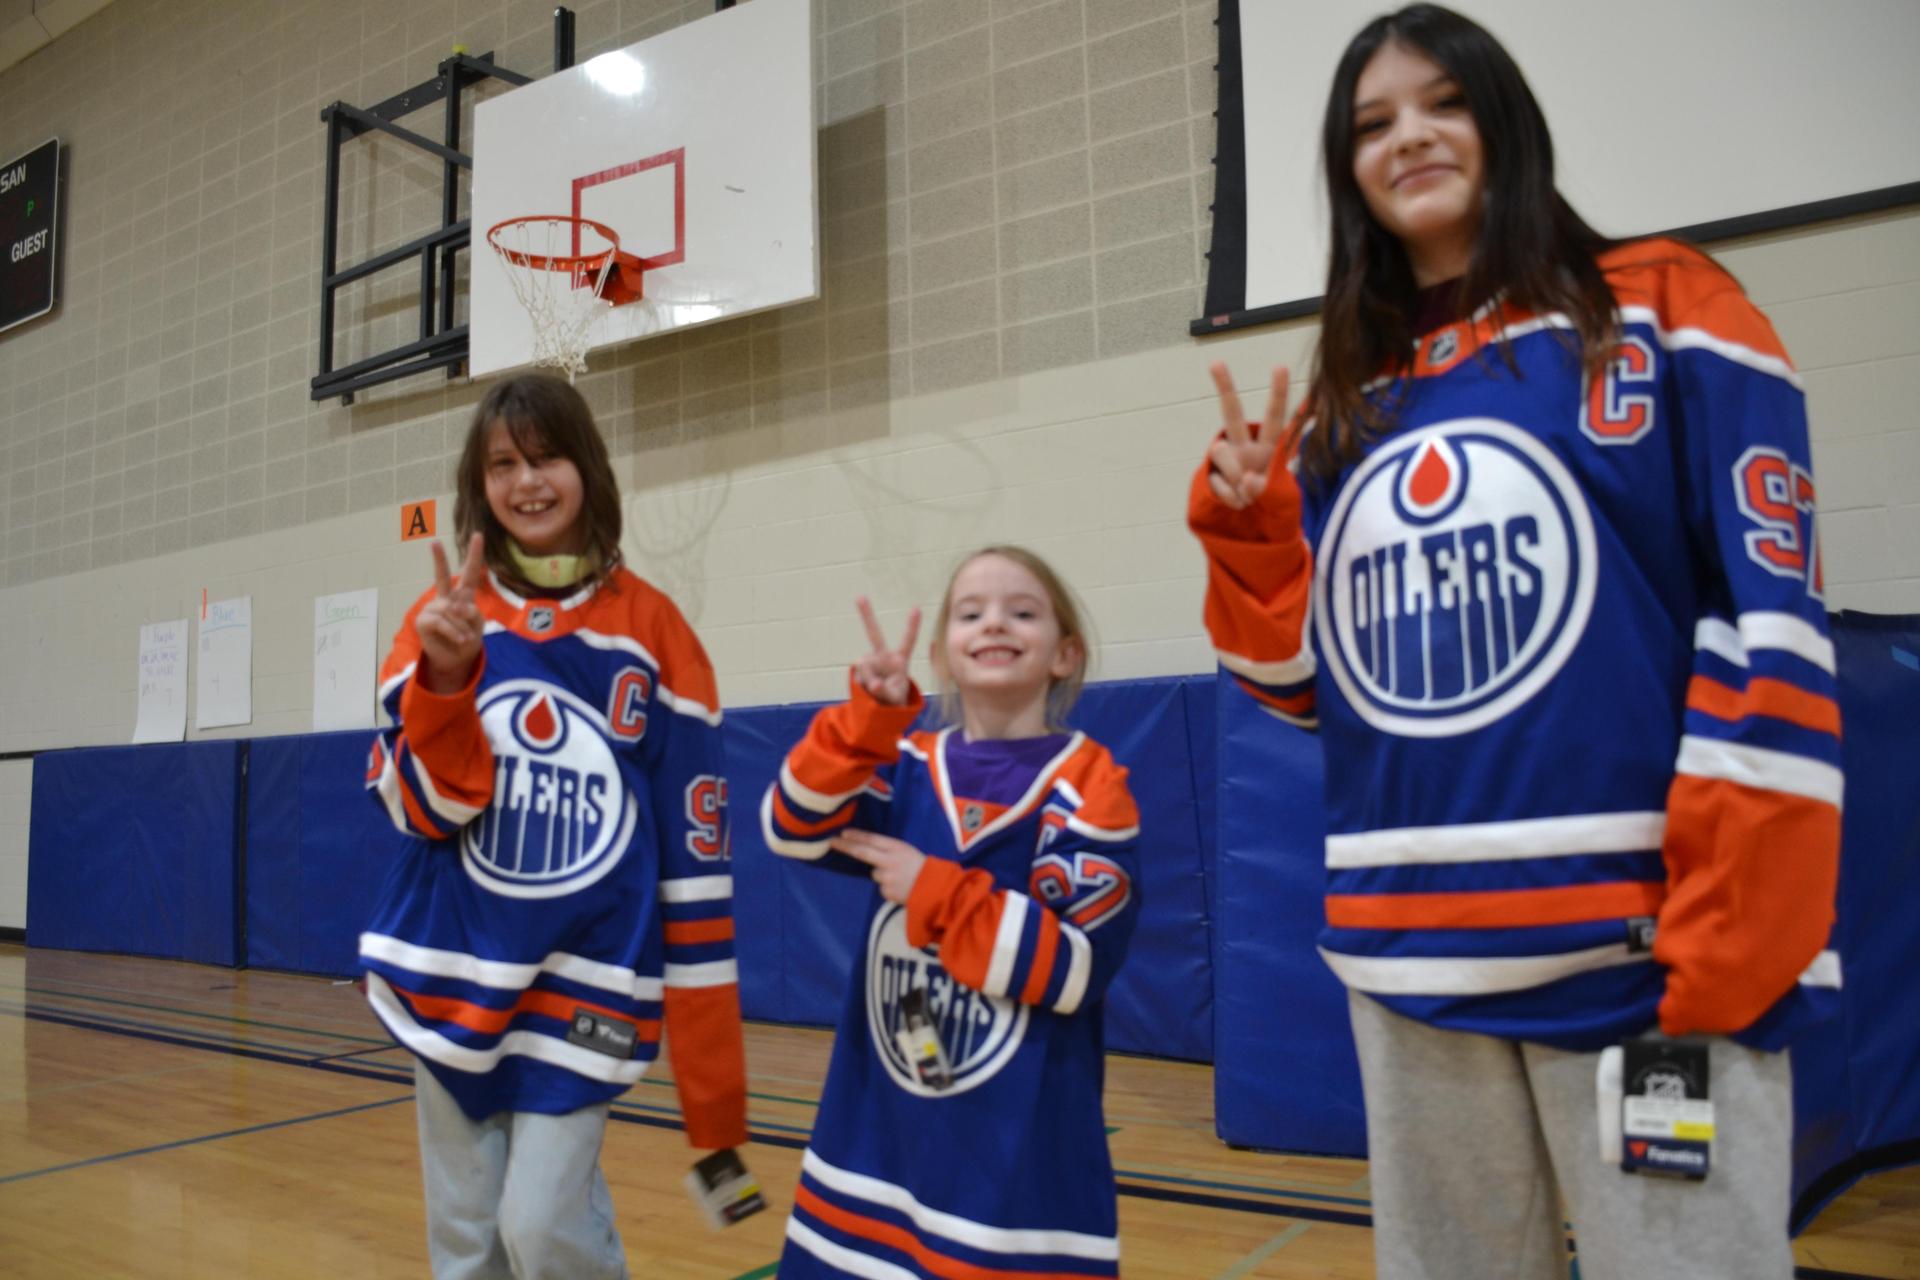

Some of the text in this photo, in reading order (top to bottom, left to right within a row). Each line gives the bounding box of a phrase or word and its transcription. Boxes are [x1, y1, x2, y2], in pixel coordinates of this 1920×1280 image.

[0, 163, 27, 194] SAN
[27, 200, 35, 217] P
[11, 228, 48, 263] GUEST
[1580, 336, 1655, 444] C
[408, 505, 428, 536] A
[1349, 515, 1543, 668] OILERS
[608, 666, 651, 743] C
[685, 774, 732, 861] 9
